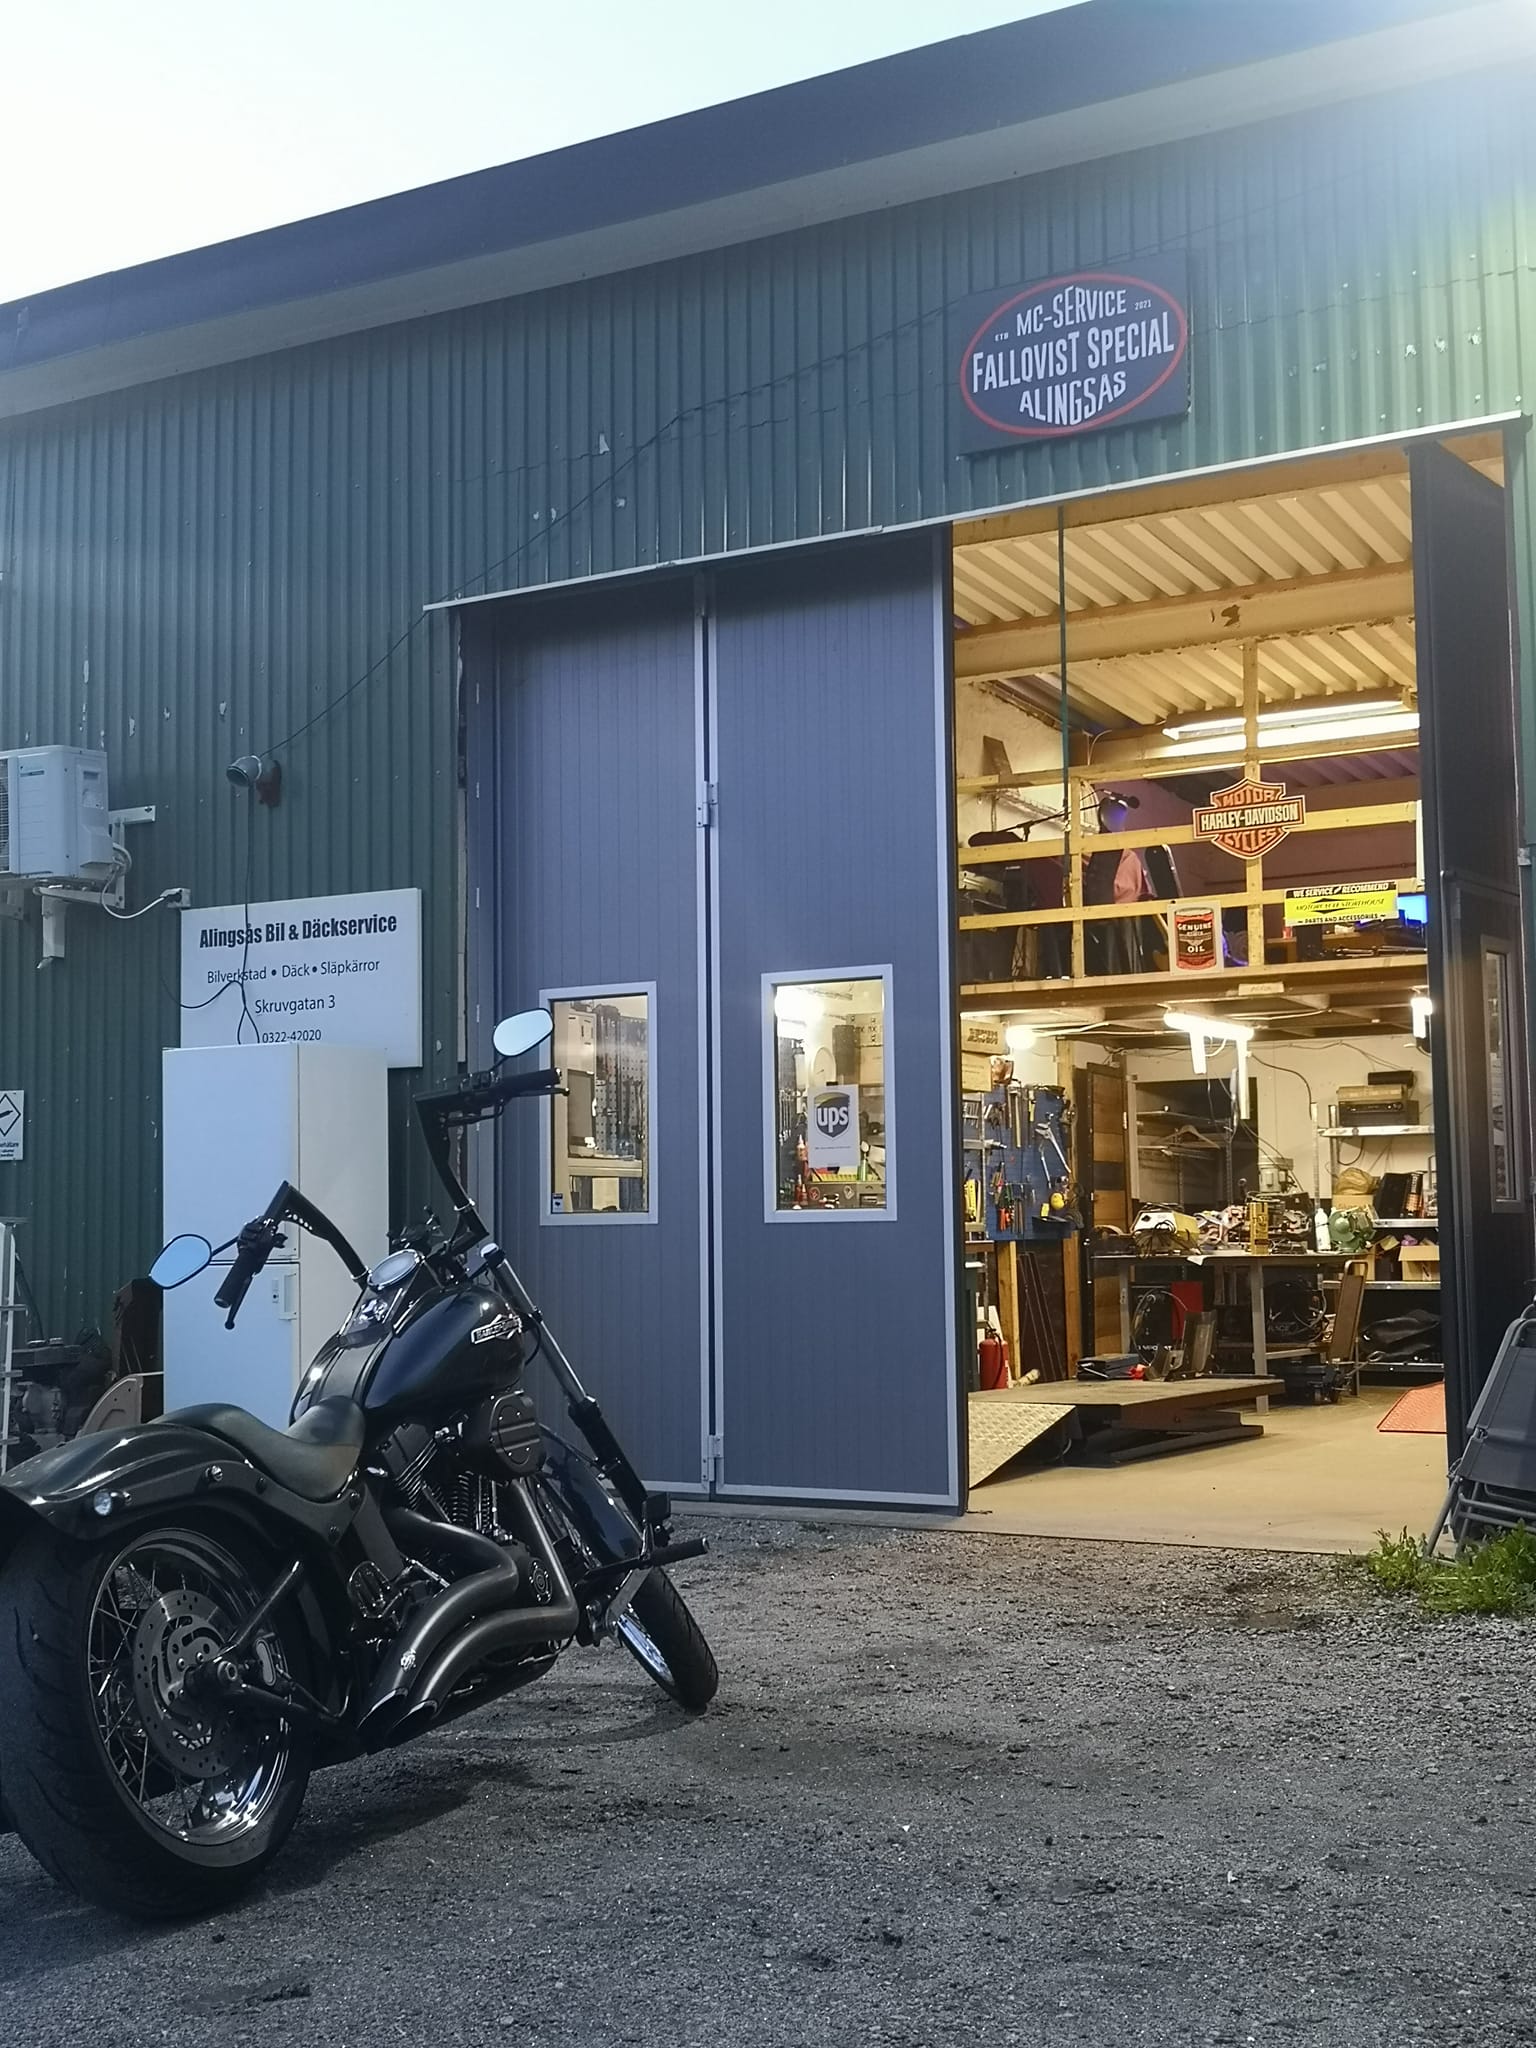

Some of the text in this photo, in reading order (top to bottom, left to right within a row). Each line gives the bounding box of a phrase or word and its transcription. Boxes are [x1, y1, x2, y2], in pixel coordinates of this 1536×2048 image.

[1016, 285, 1127, 337] MC-SERVICE
[1134, 300, 1152, 311] 2021
[972, 311, 1175, 393] FALLQVIST SPECIAL
[1019, 371, 1127, 426] ALINGSAS
[1222, 787, 1276, 807] MOTOR
[1200, 802, 1298, 832] HARLEY-DAVIDSON
[1224, 827, 1277, 852] CYCLES
[1292, 889, 1304, 898] WE
[1305, 887, 1334, 897] SERVICE
[1177, 922, 1212, 931] GENUINE
[1339, 913, 1379, 921] ACCESSORIES
[200, 914, 397, 949] Alingsås Bil & Däckservice
[1187, 945, 1206, 953] OIL
[207, 960, 380, 983] Bilverkstad Däck Släpkärror
[255, 995, 336, 1014] Skruvgatan 3
[817, 1106, 849, 1133] ups
